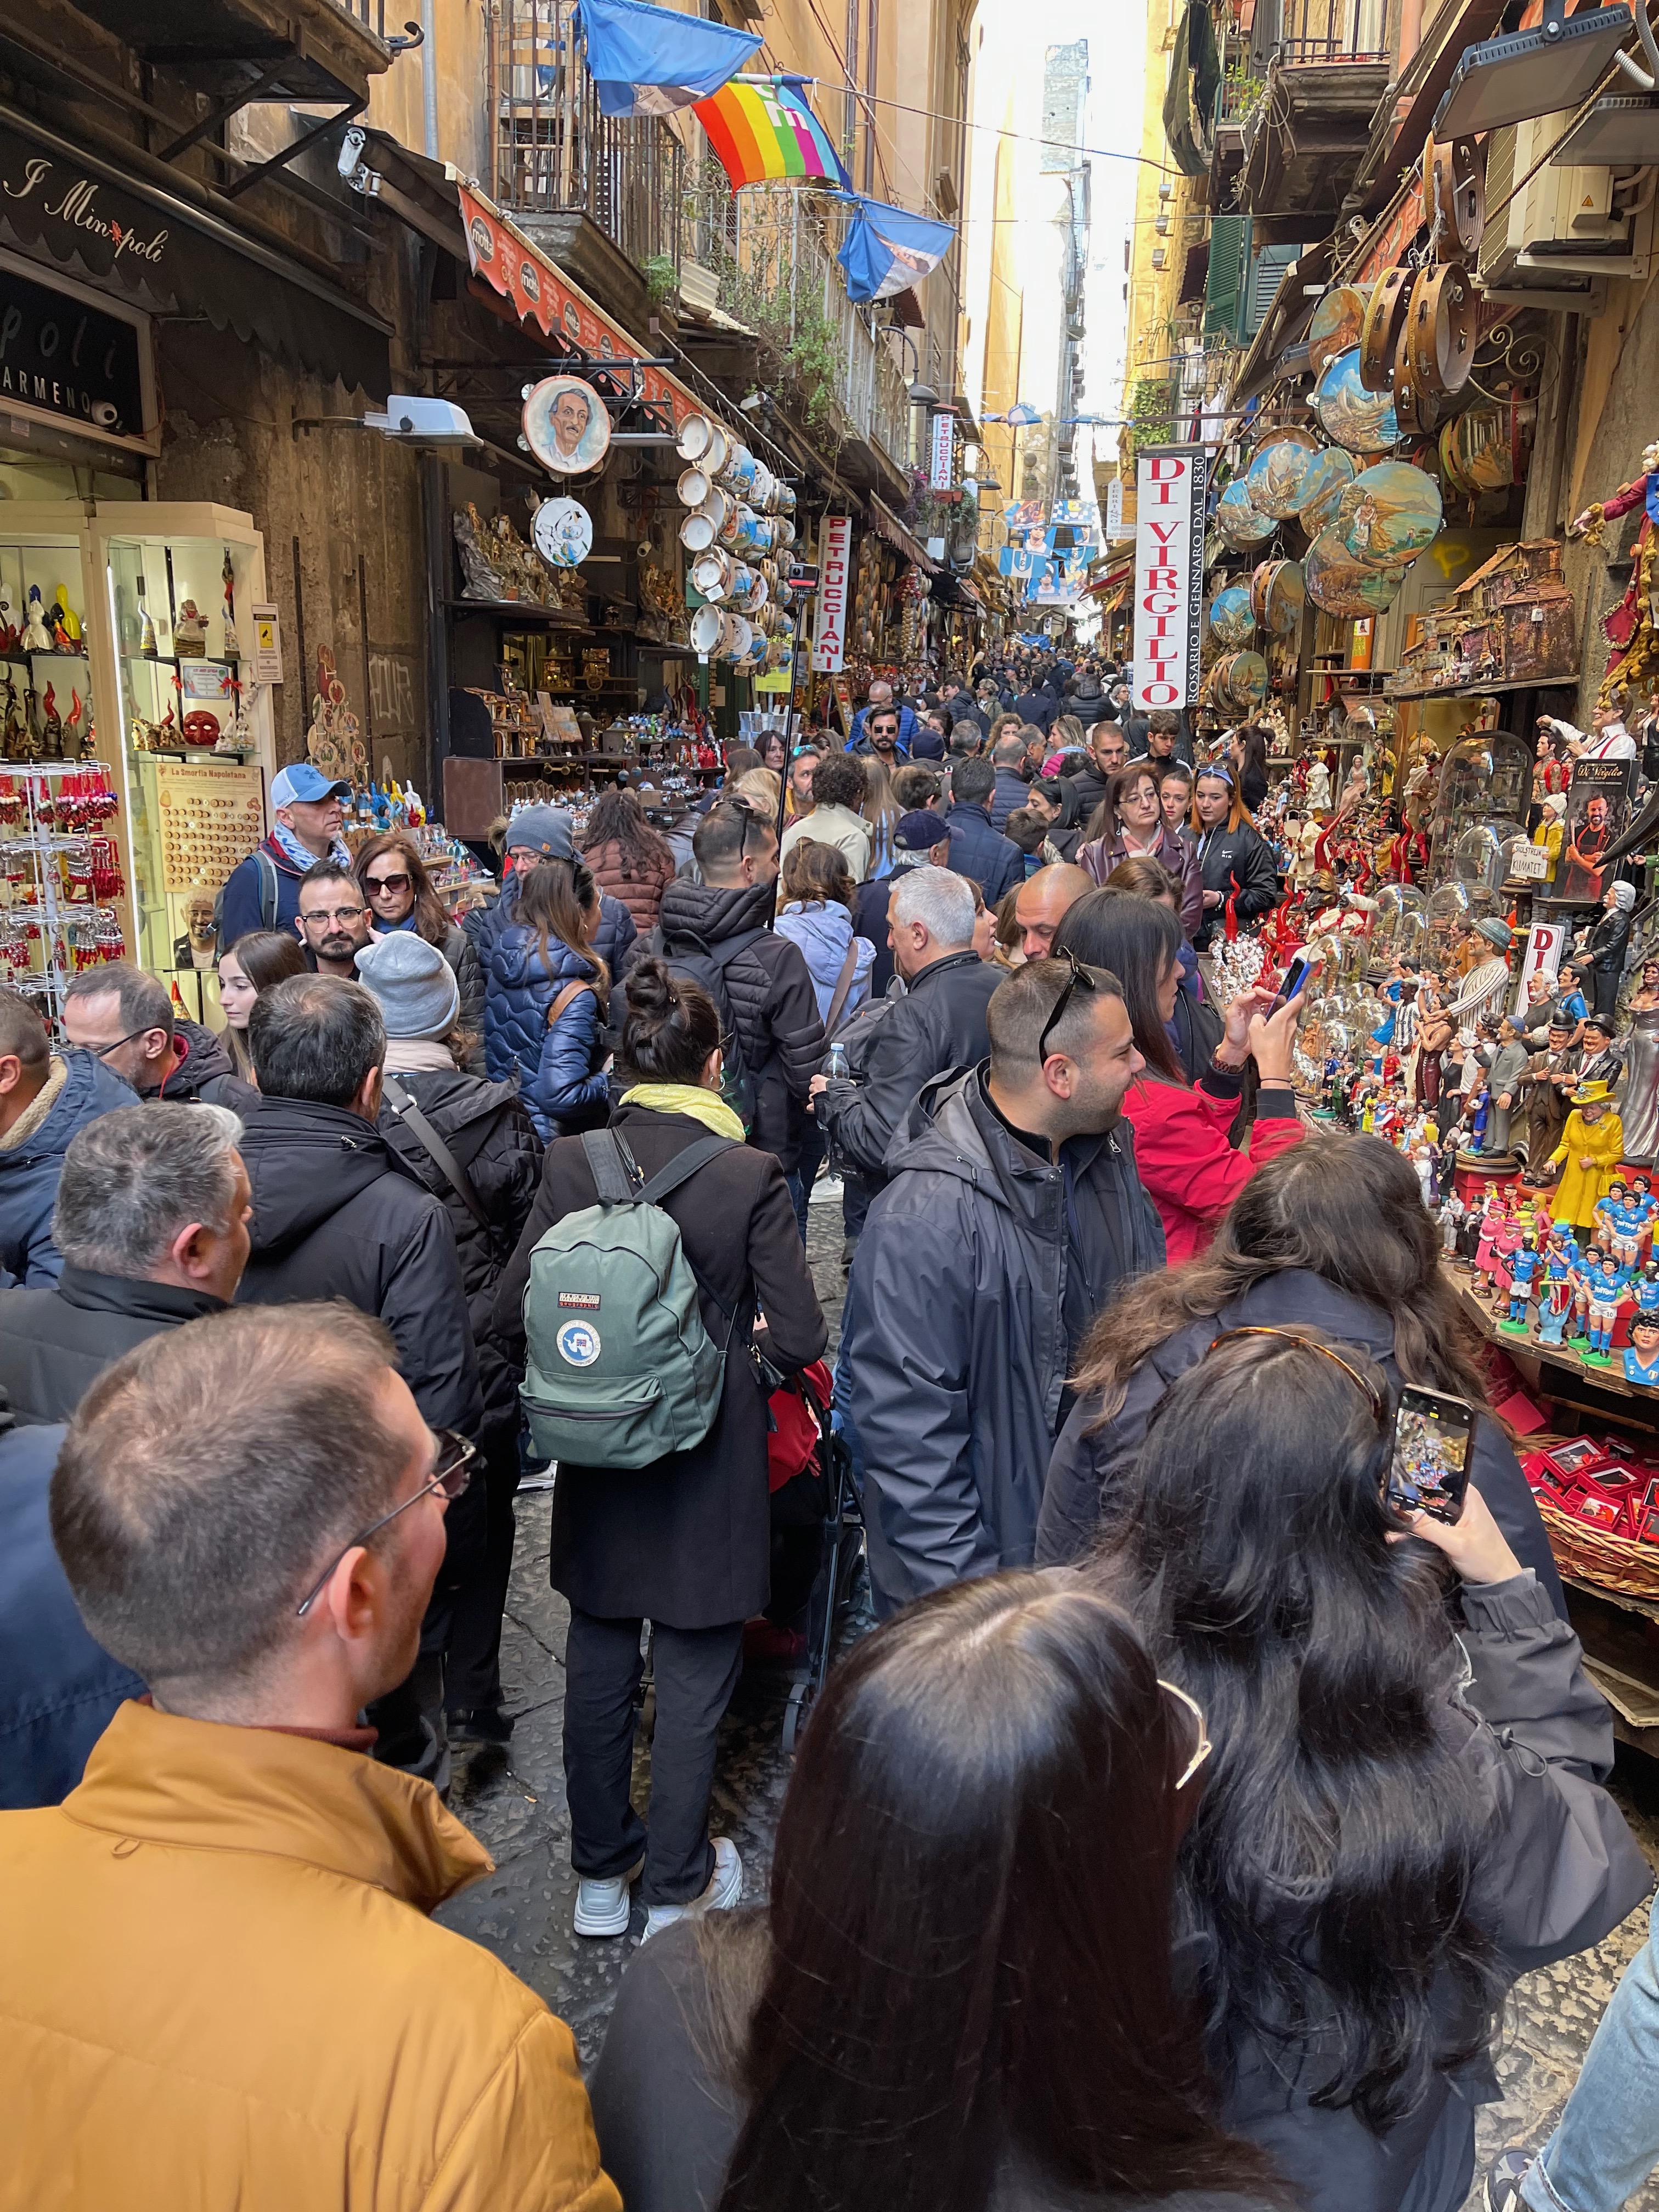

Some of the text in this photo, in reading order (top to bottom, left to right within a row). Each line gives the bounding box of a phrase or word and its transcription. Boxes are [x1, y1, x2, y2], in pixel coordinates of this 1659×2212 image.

[44, 180, 168, 262] Minpoli
[472, 228, 493, 257] motta
[522, 273, 540, 297] motta
[938, 416, 950, 488] PETRUCCIANI
[1193, 456, 1205, 492] 1830
[1193, 498, 1203, 528] DAL
[820, 518, 847, 670] PETRUCCIANI
[1142, 459, 1185, 704] DI VIRGILIO
[1189, 534, 1202, 616] GENNARO
[1187, 634, 1199, 703] ROSARIO
[181, 769, 207, 777] Smorfia
[208, 770, 246, 779] Napoletana
[1578, 765, 1623, 780] Di Virgilio
[1512, 858, 1542, 874] KLIMATET
[1533, 929, 1553, 971] DI
